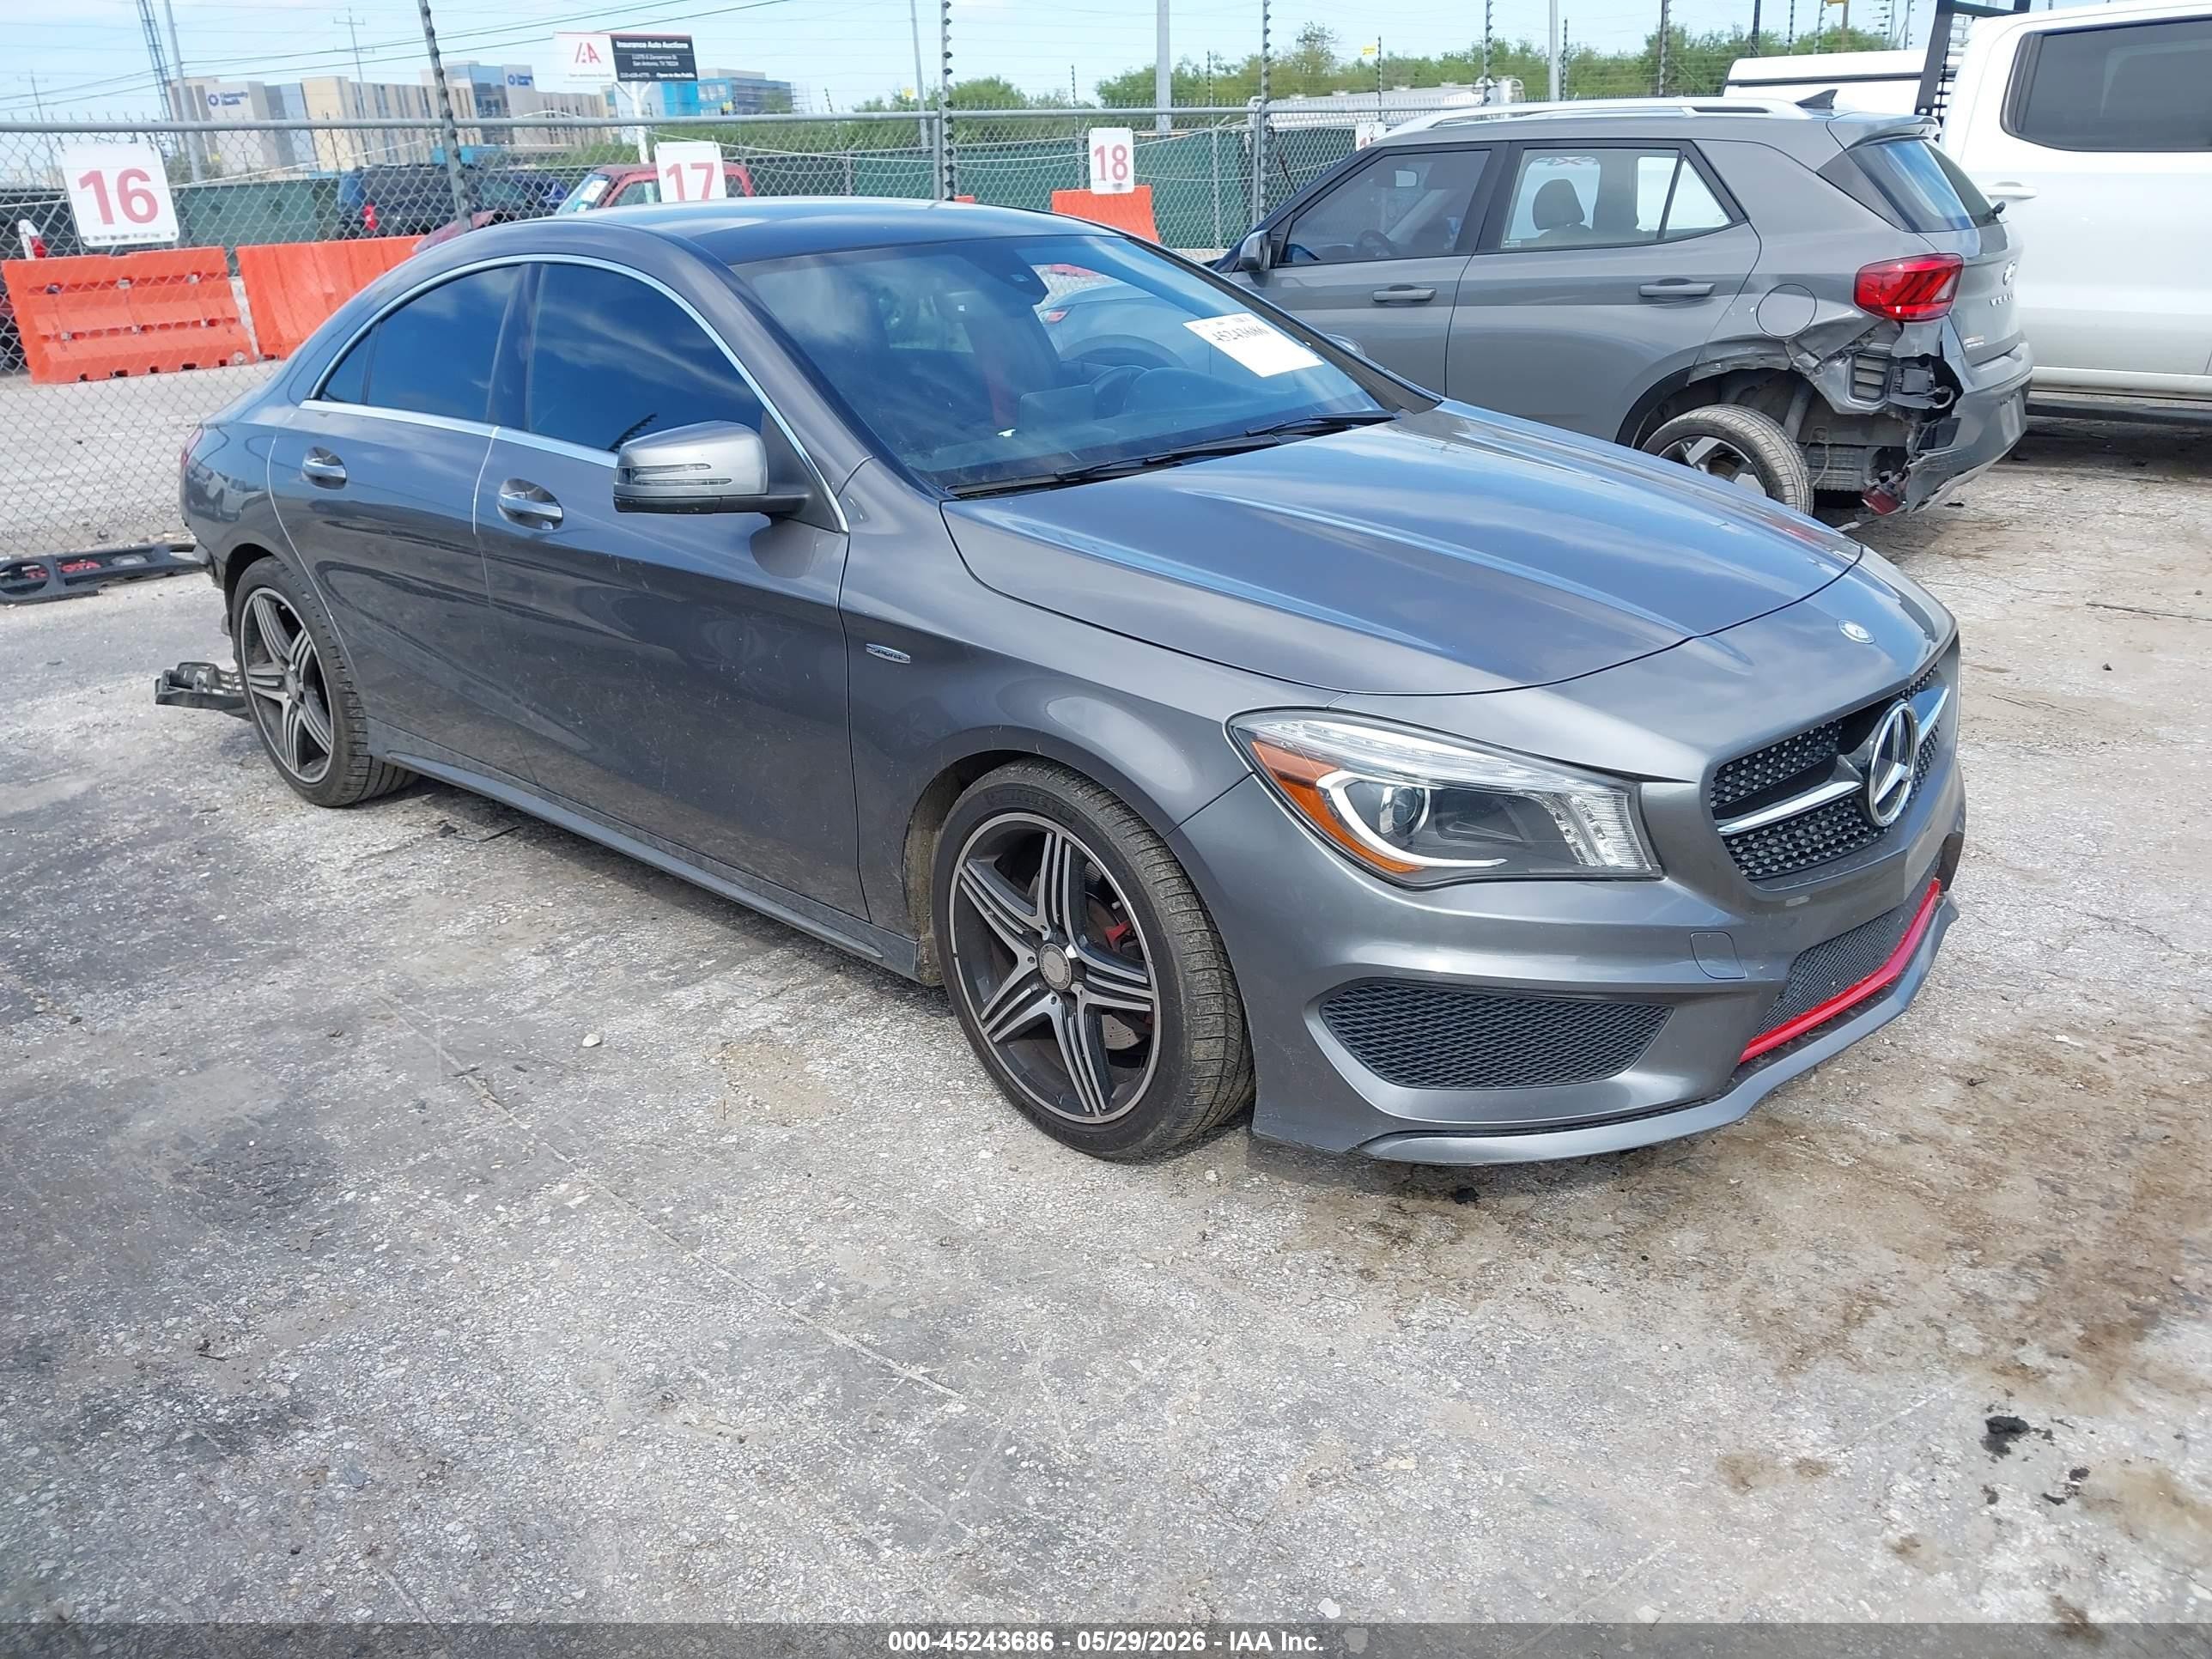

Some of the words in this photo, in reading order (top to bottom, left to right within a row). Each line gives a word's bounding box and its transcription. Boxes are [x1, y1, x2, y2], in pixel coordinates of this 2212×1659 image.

[647, 40, 662, 49] Auto
[665, 161, 714, 201] 17
[1093, 143, 1128, 181] 18
[78, 168, 159, 225] 16
